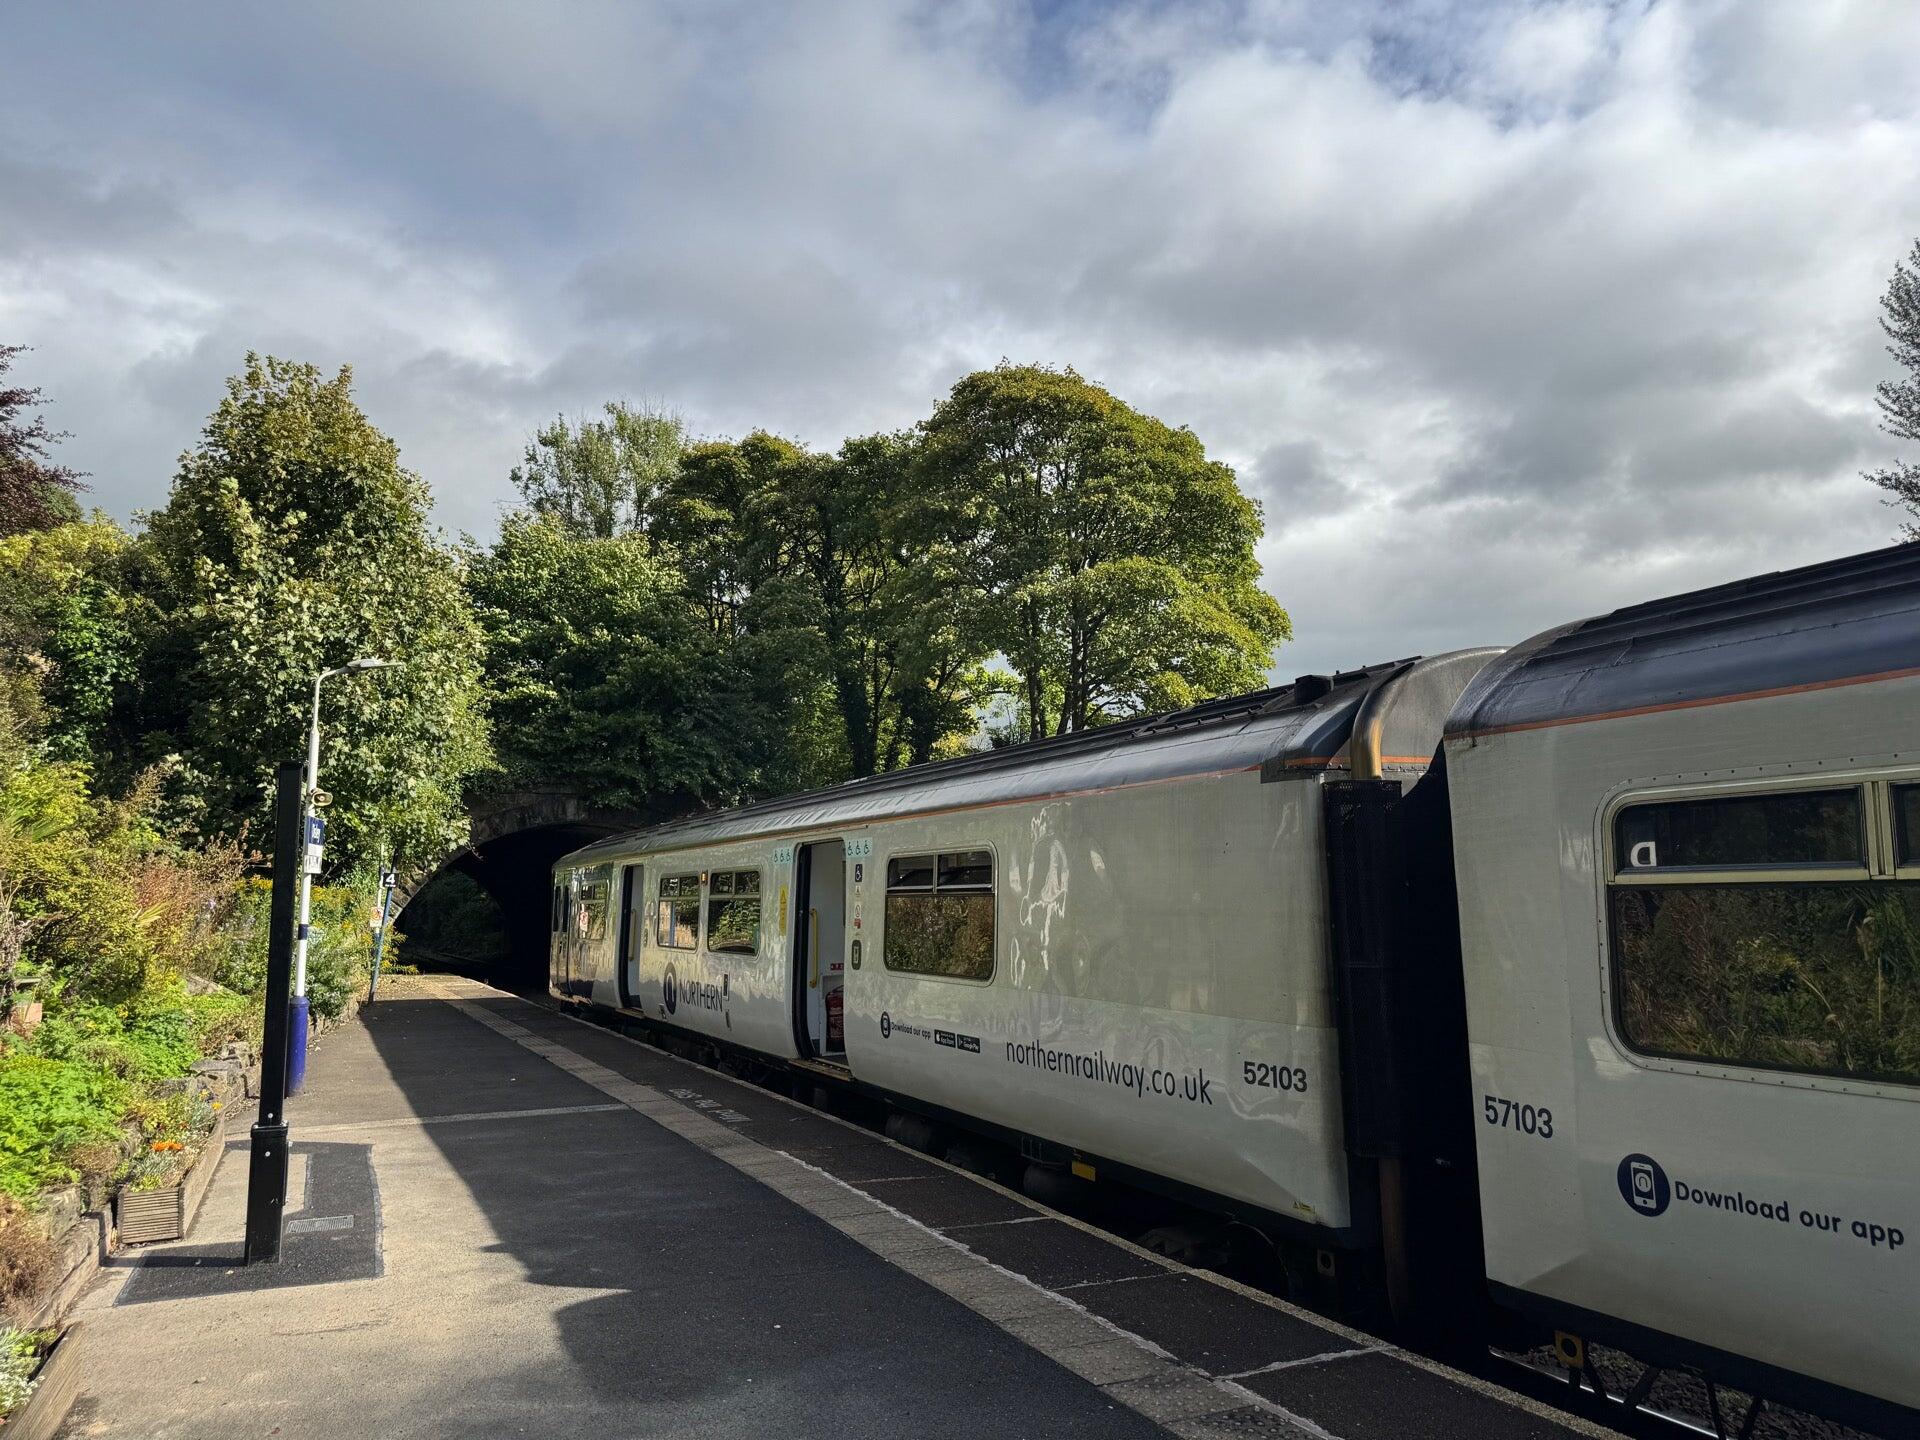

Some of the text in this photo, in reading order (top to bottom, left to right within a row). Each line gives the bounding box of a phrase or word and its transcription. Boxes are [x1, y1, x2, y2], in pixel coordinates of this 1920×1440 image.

[386, 873, 395, 884] 4
[679, 980, 723, 1012] NORTHERN
[891, 1022, 912, 1034] Download
[913, 1028, 921, 1036] our
[922, 1030, 931, 1040] app
[1006, 1039, 1212, 1105] northernrailway.co.uk
[1243, 1061, 1307, 1092] 52103
[1485, 1094, 1553, 1139] 57103
[1675, 1180, 1905, 1250] Download our app
